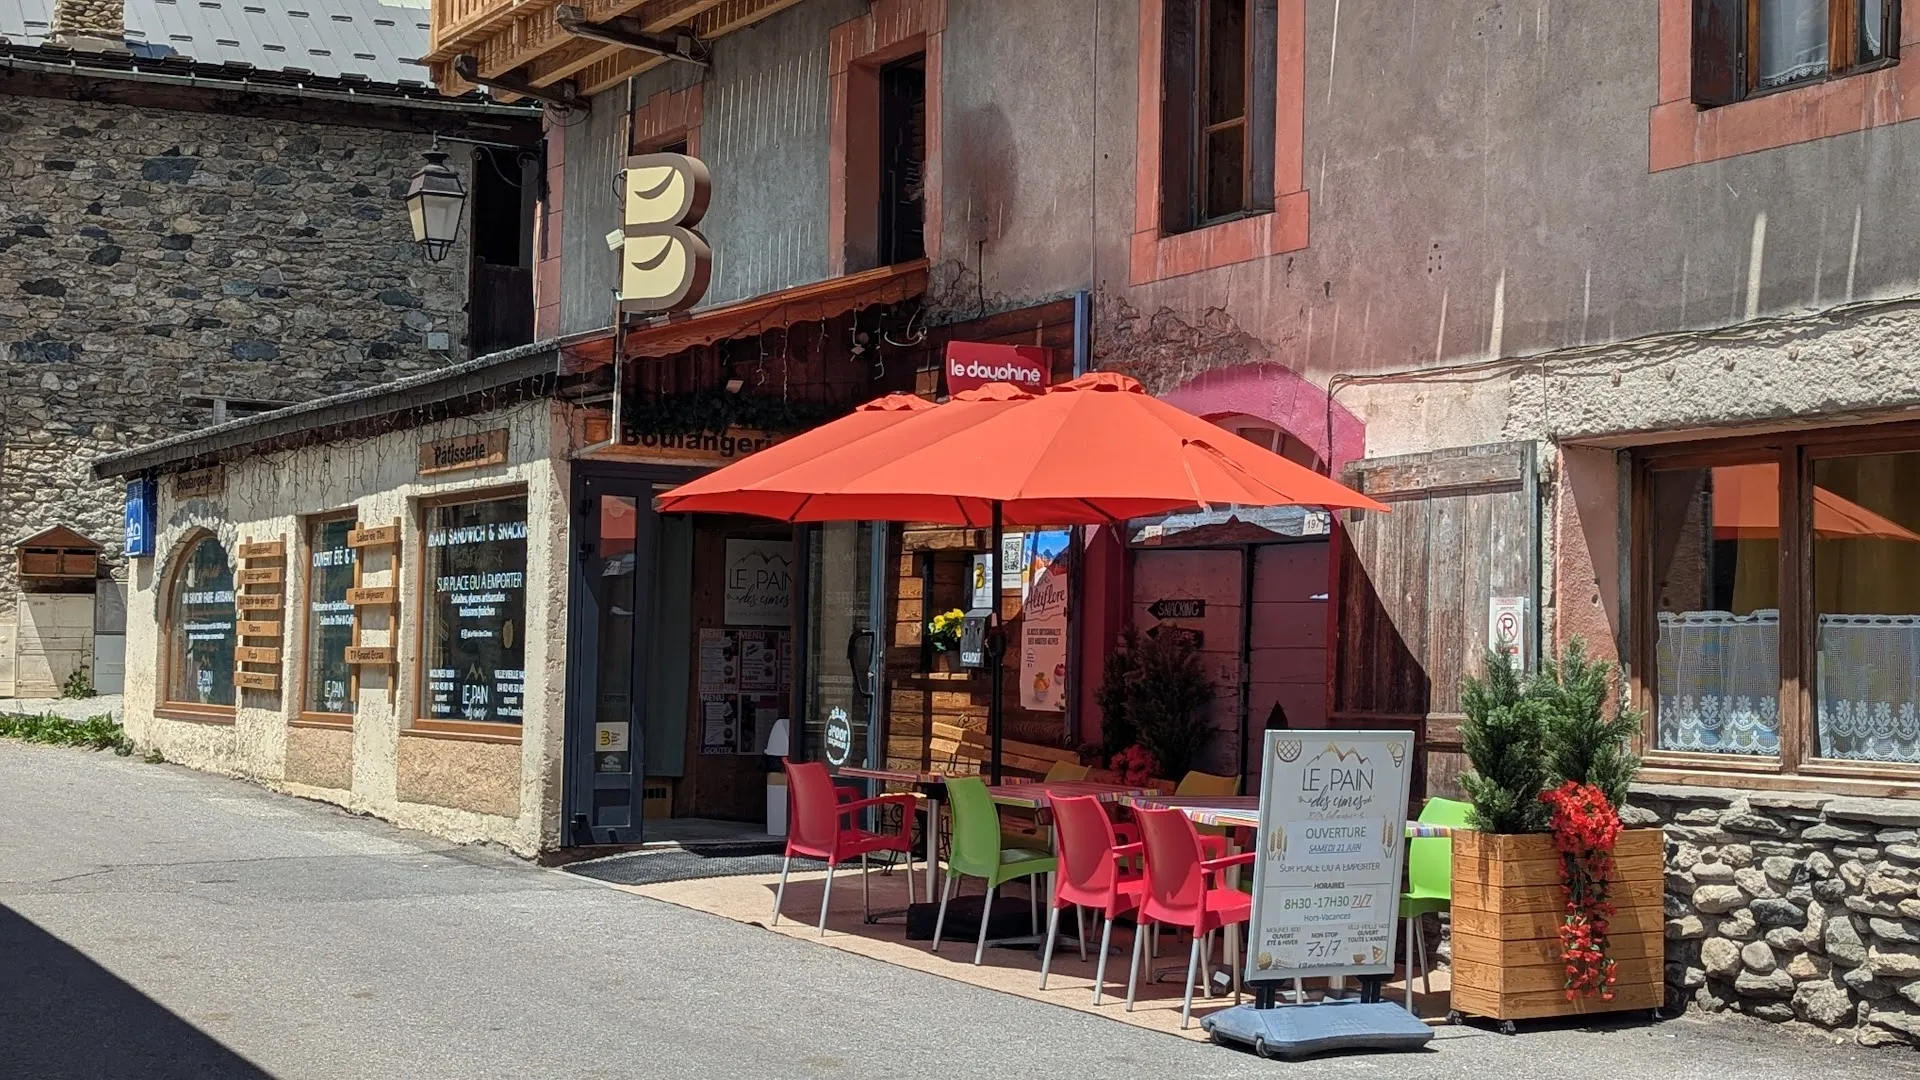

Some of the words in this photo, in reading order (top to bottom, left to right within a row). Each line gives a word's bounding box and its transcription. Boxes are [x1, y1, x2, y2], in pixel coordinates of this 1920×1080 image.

[951, 359, 965, 376] le
[967, 360, 1041, 382] dauphiné
[621, 425, 776, 457] Boulangeri
[448, 525, 486, 545] SANDWICH
[488, 523, 495, 541] &
[437, 576, 449, 592] SUR
[449, 575, 469, 591] PLACE
[469, 574, 481, 590] OU
[487, 572, 523, 589] EMPORTER
[729, 568, 747, 590] LE
[1157, 601, 1200, 617] SNACKING
[462, 684, 471, 704] LE
[1302, 768, 1321, 791] LE
[1330, 768, 1374, 791] PAIN
[1310, 784, 1331, 811] des
[1333, 795, 1363, 811] cimes
[1306, 826, 1367, 839] OUVERTURE
[1309, 844, 1336, 852] SAMEDI
[1346, 843, 1362, 851] JUIN
[1342, 862, 1380, 872] EMPORTER
[1284, 898, 1312, 909] 8H30
[1303, 913, 1351, 921] Hors-Vacances
